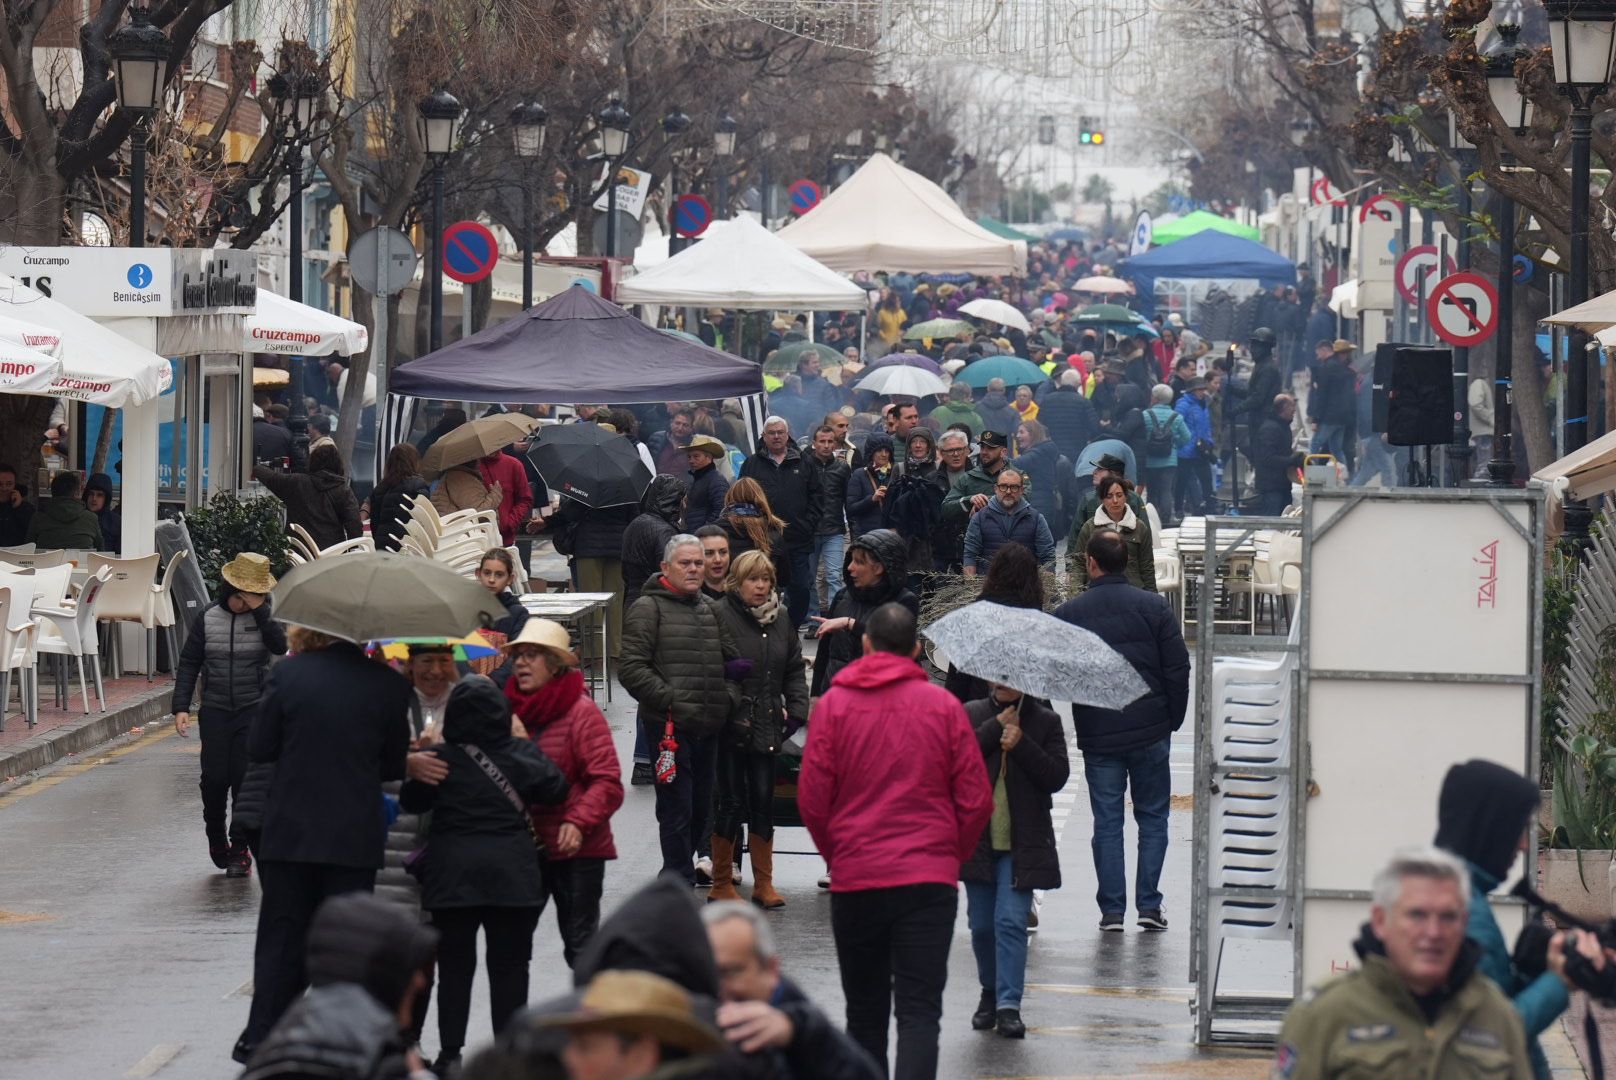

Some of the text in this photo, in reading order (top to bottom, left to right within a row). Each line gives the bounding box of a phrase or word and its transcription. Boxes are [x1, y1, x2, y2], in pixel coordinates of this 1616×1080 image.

[23, 255, 70, 266] Cruzcampo
[252, 327, 321, 345] Cruzcampo
[265, 343, 304, 353] ESPECIAL
[1472, 539, 1499, 609] TALÍA
